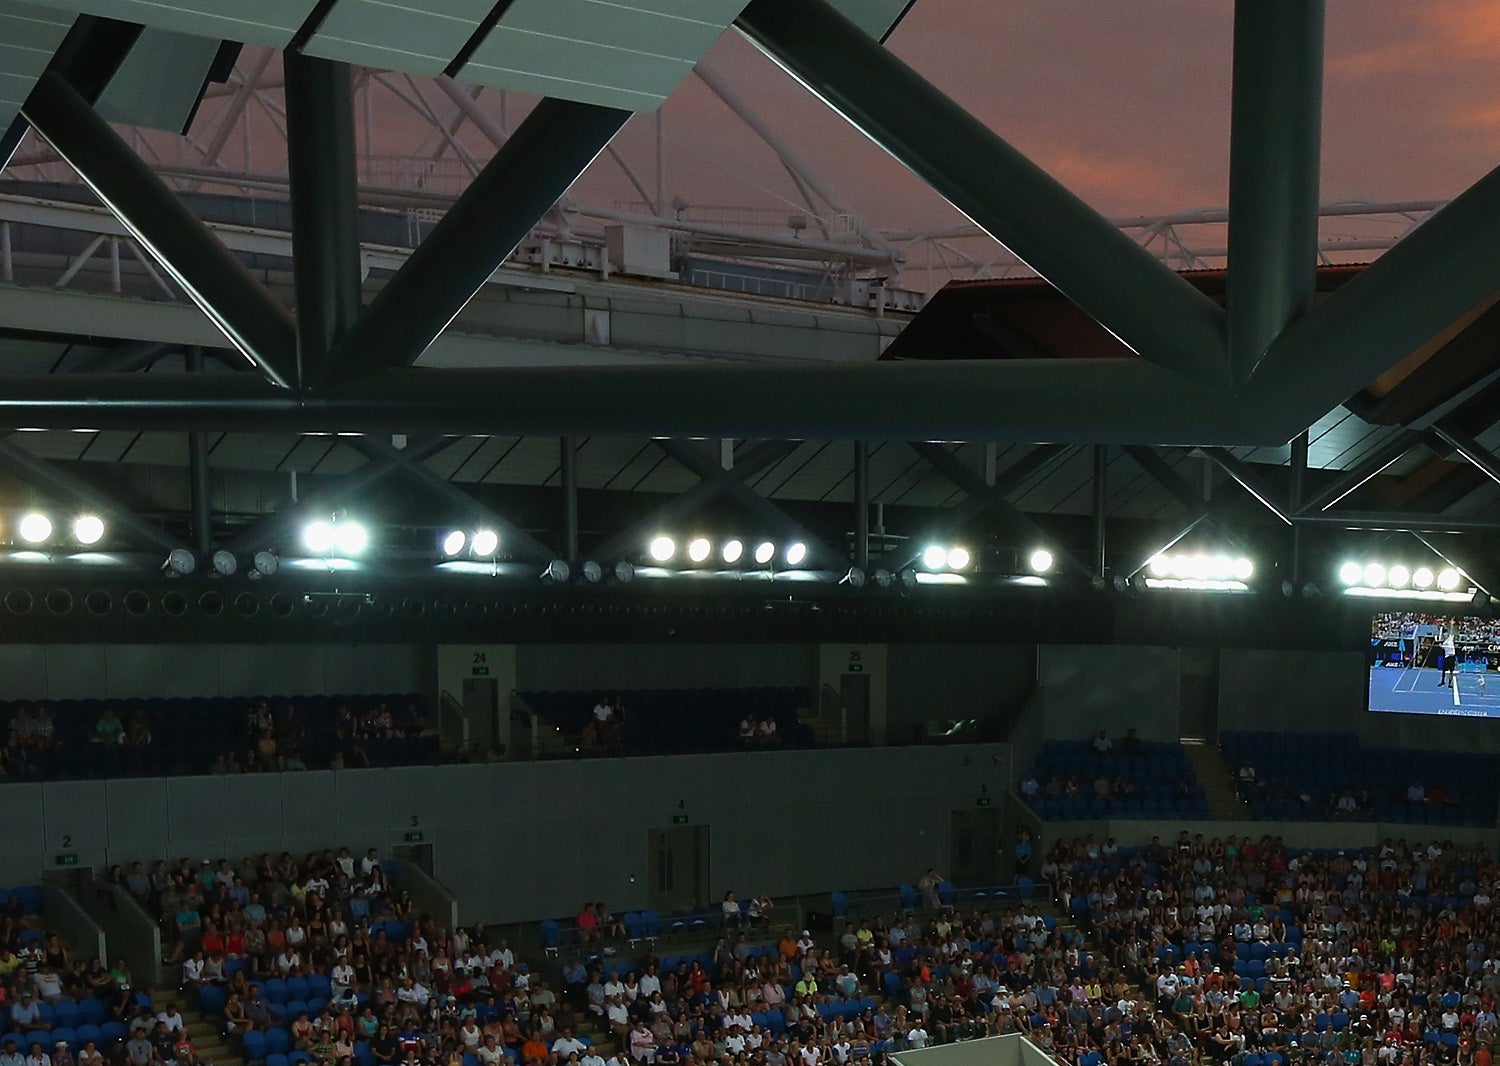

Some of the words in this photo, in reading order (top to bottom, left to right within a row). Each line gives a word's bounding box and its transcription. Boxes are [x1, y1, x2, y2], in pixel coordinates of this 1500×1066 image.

[473, 653, 487, 664] 24
[850, 651, 861, 661] 25
[678, 799, 685, 810] 4
[411, 815, 419, 827] 3
[62, 835, 72, 848] 2
